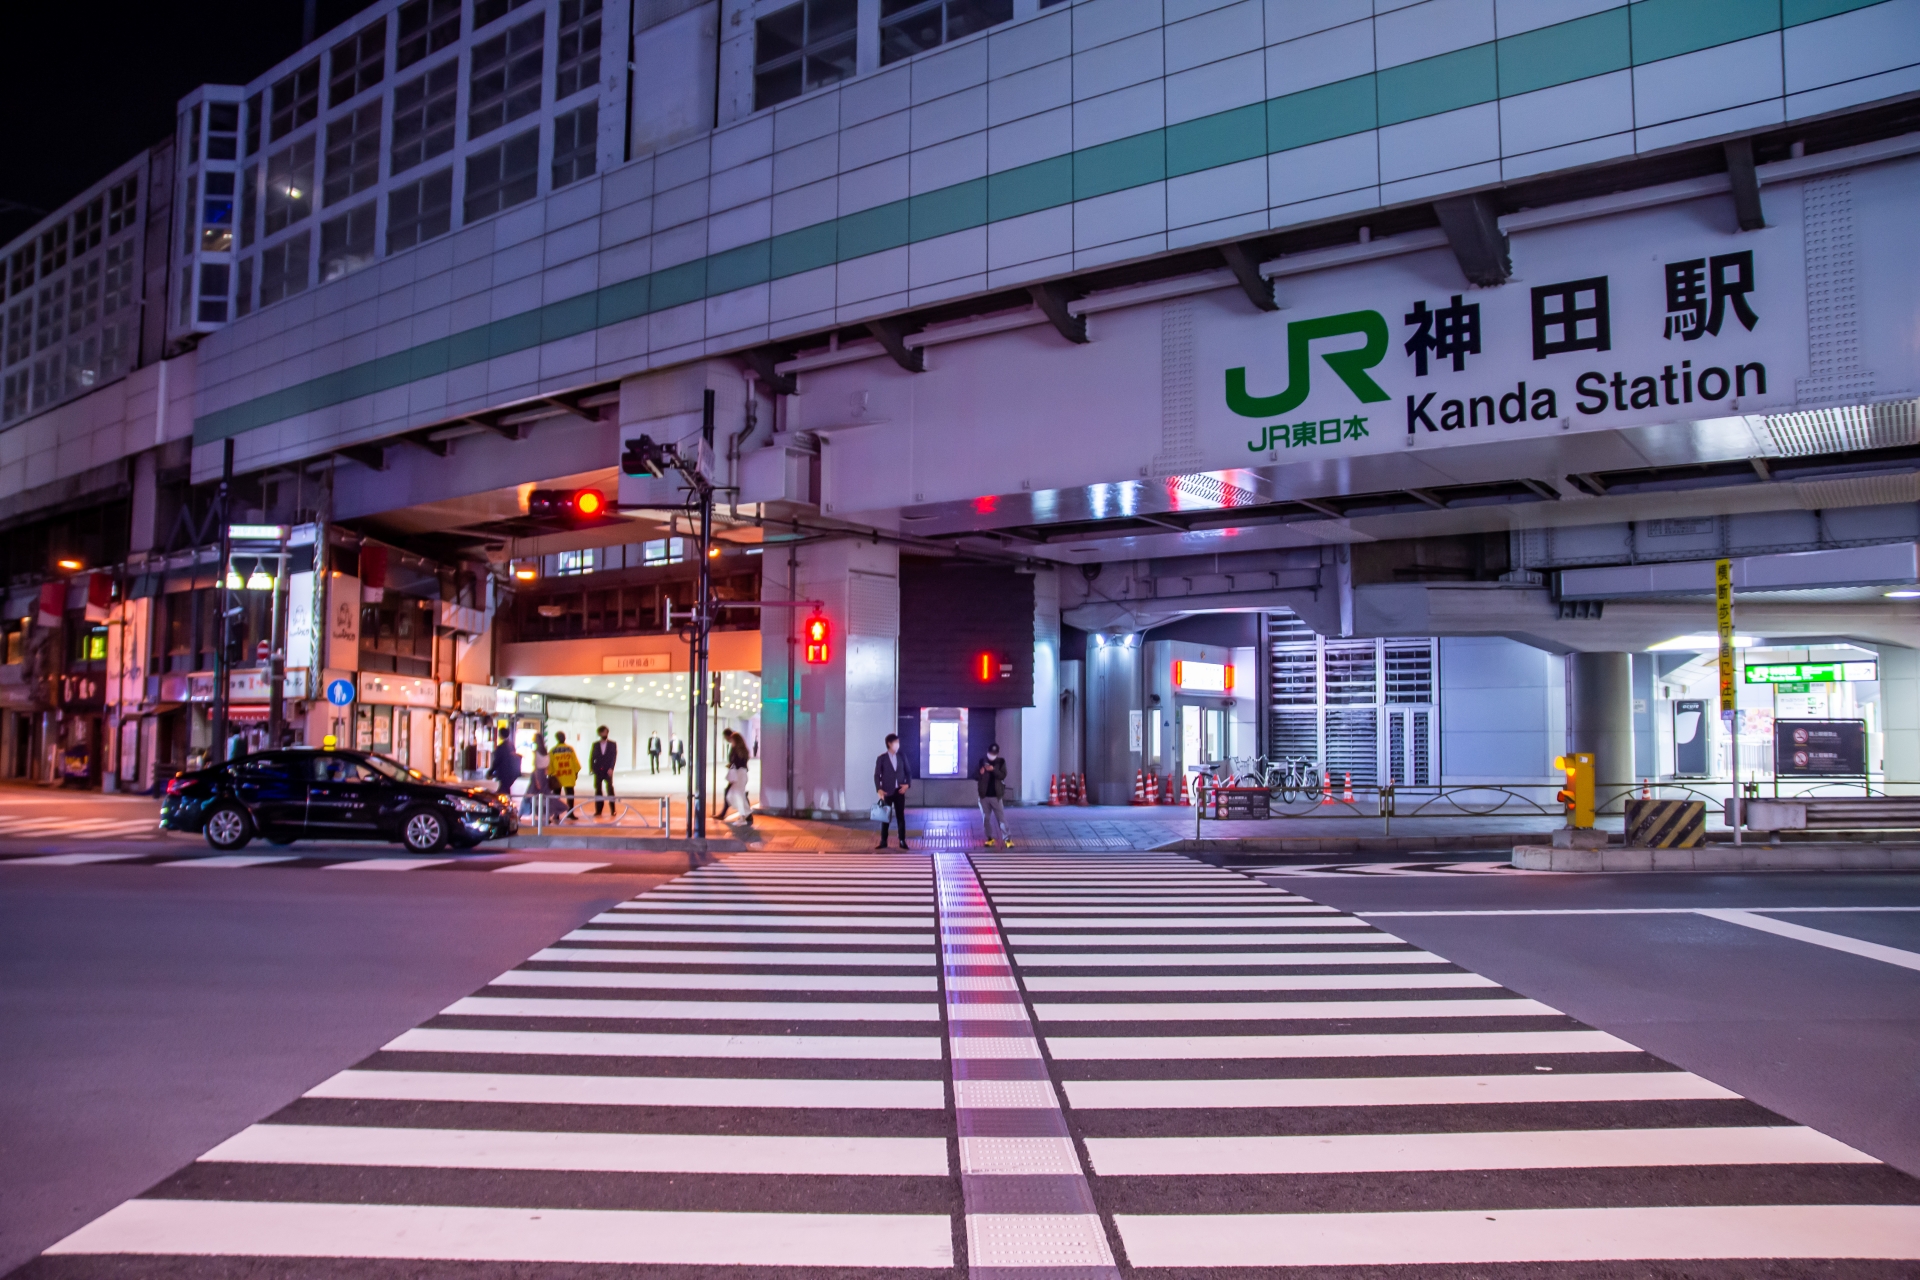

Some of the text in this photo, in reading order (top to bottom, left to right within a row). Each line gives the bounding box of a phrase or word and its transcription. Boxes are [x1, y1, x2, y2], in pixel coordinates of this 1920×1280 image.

[1225, 310, 1391, 418] JR
[1404, 250, 1758, 377] 神田駅
[1247, 415, 1370, 453] JR東日本
[1407, 361, 1767, 435] Kanda Station
[1717, 564, 1732, 710] 横断歩行者に注意
